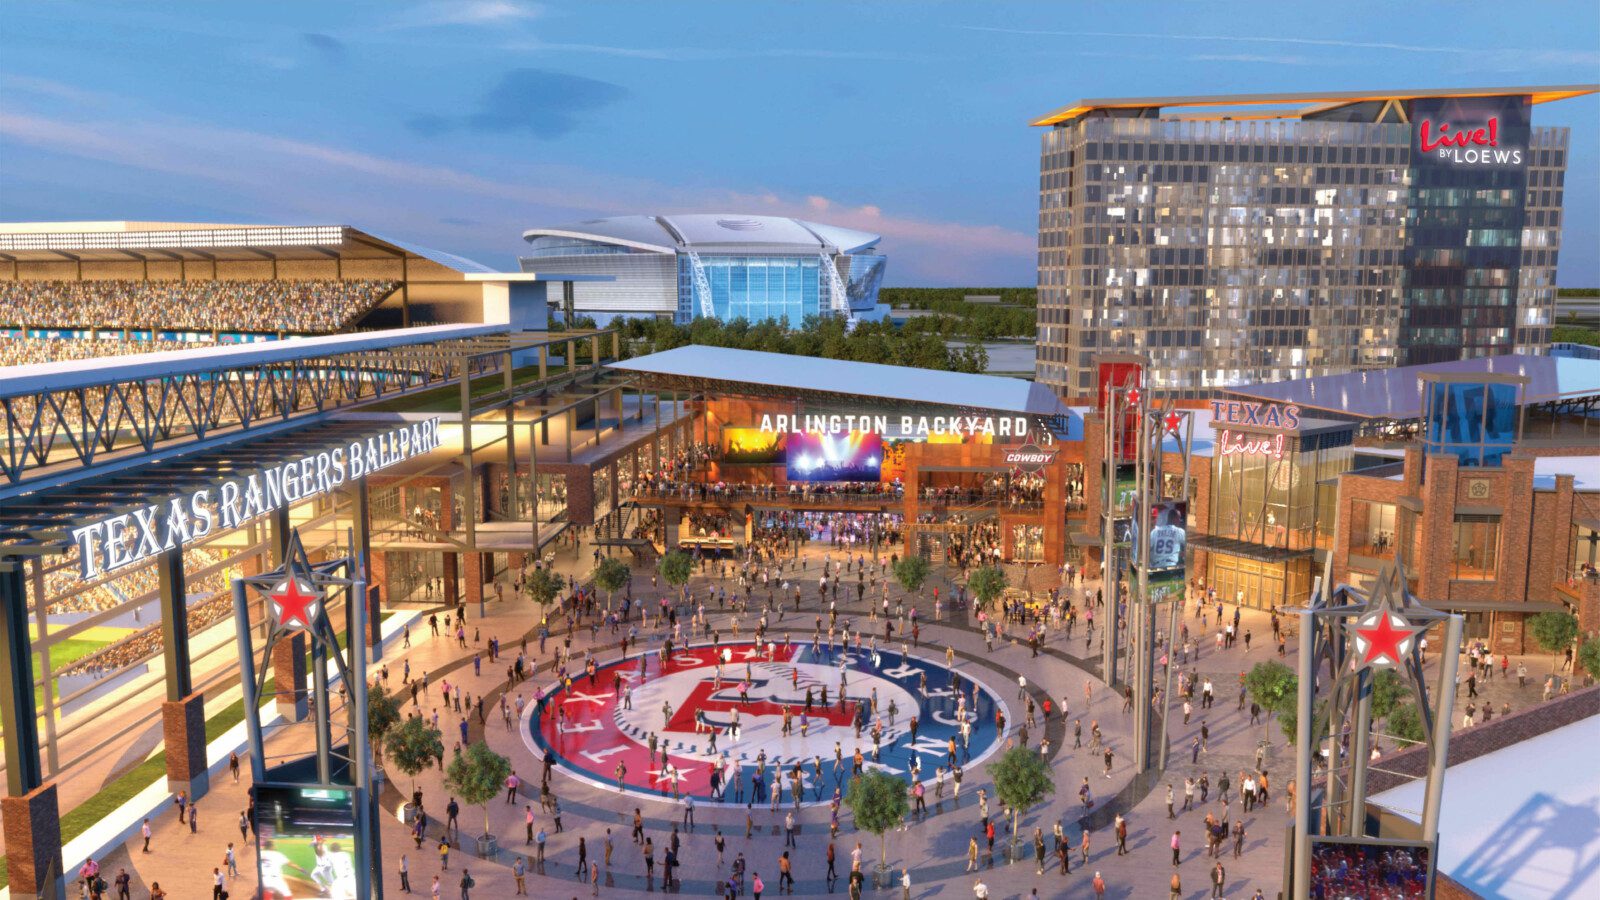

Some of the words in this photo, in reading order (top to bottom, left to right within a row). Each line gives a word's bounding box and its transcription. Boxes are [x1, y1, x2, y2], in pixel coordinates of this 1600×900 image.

[1420, 117, 1498, 152] Live!
[1439, 149, 1452, 158] BY
[1454, 150, 1521, 164] LOEWS
[761, 414, 886, 434] ARLINGTON
[901, 416, 1027, 437] BACKYARD
[1210, 400, 1299, 430] TEXAS
[1221, 431, 1284, 457] Live!
[1007, 454, 1052, 462] COWBOY
[72, 489, 213, 580] TEXAS
[221, 446, 346, 530] RANGERS
[349, 416, 442, 480] BALLPARK
